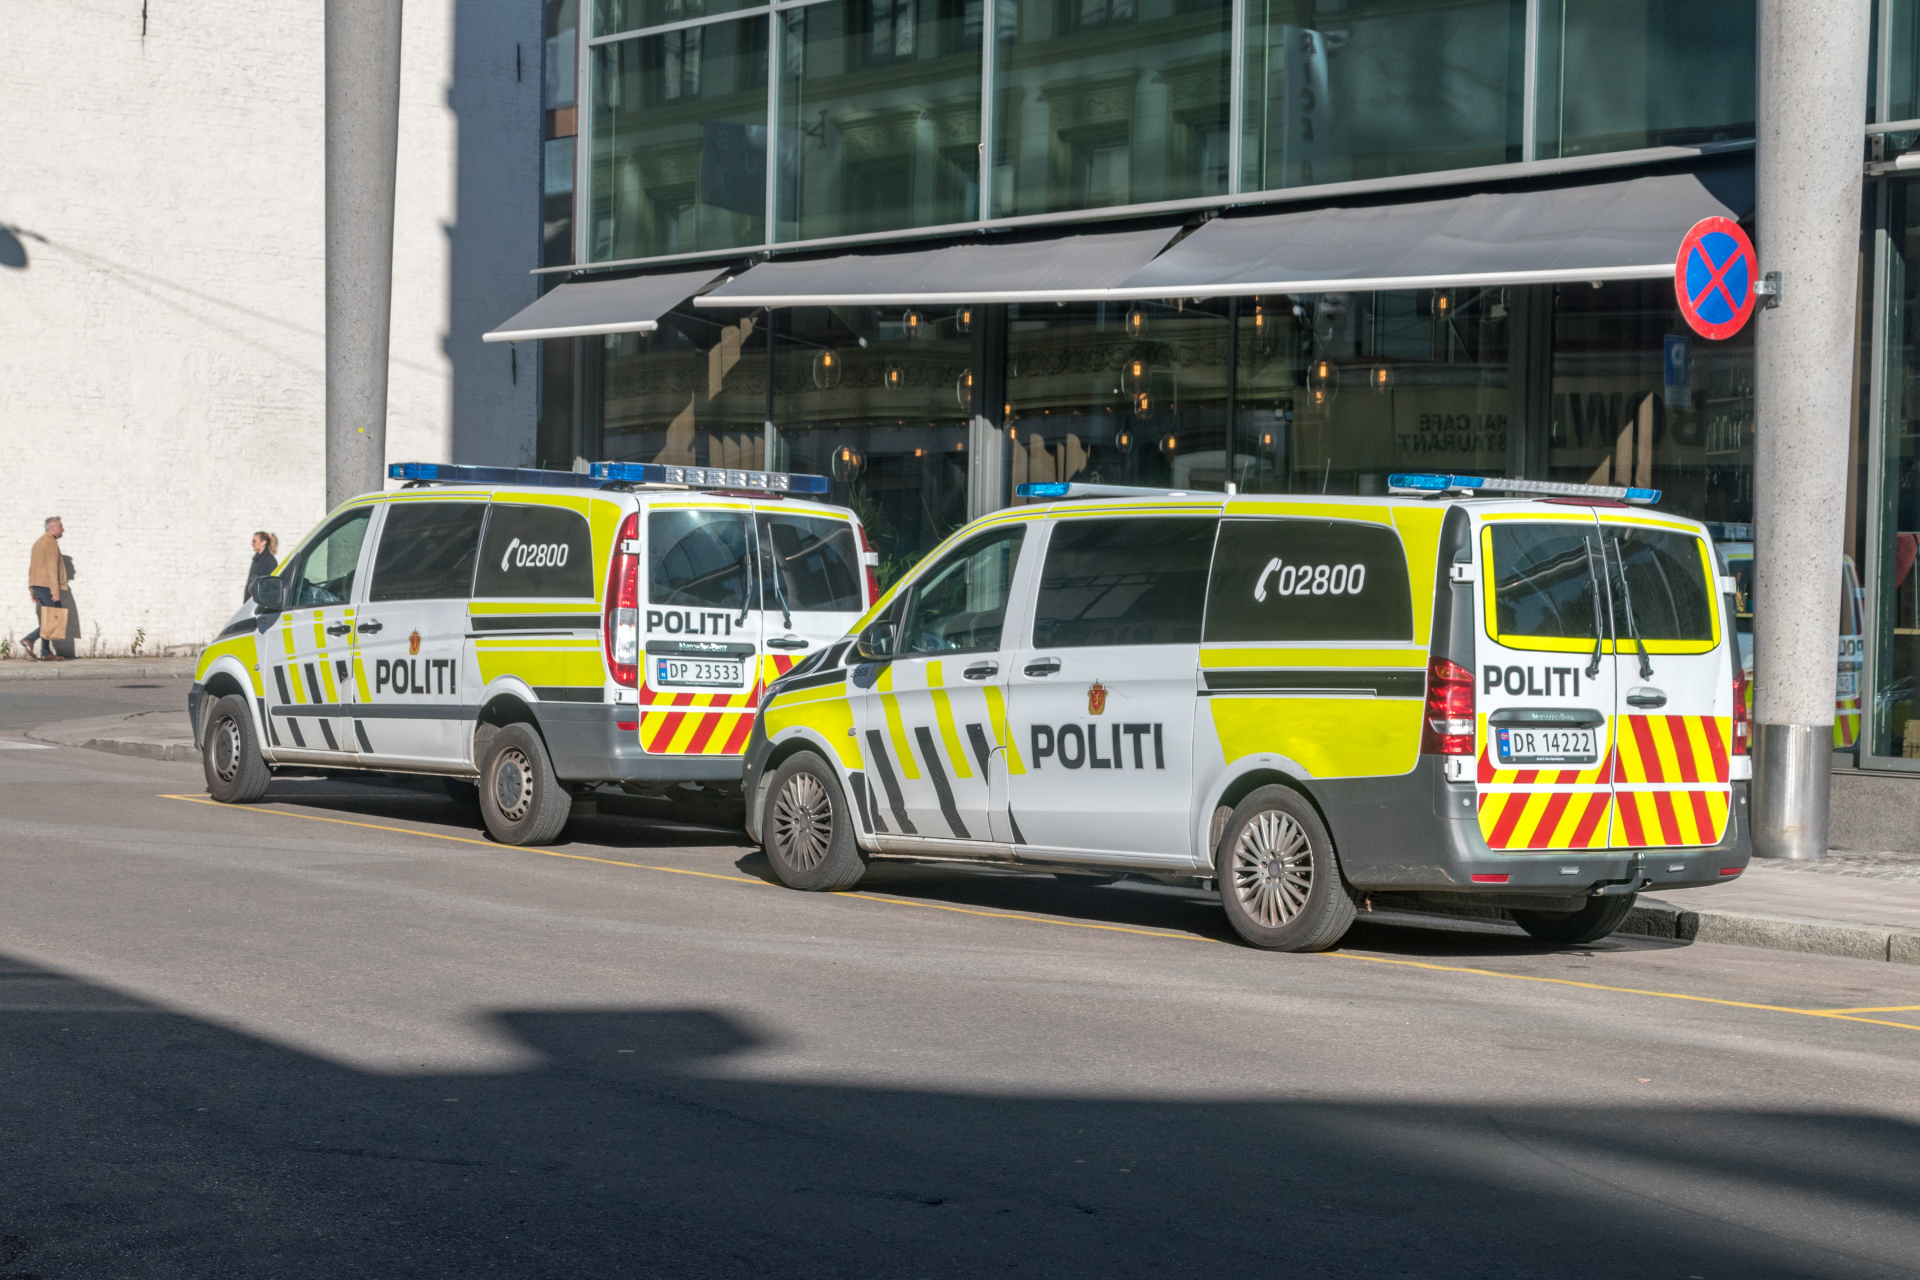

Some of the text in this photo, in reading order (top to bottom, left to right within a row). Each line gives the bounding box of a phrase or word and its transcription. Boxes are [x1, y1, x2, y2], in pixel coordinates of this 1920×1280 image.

[516, 543, 569, 567] 02800
[1278, 564, 1366, 596] 02800
[646, 610, 731, 636] POLITI
[679, 642, 728, 652] Mercedes-Benz
[376, 659, 456, 695] POLITI
[669, 663, 739, 680] DP 23533
[1483, 665, 1580, 697] POLITI
[1031, 723, 1164, 769] POLITI
[1513, 733, 1590, 753] DR 14222
